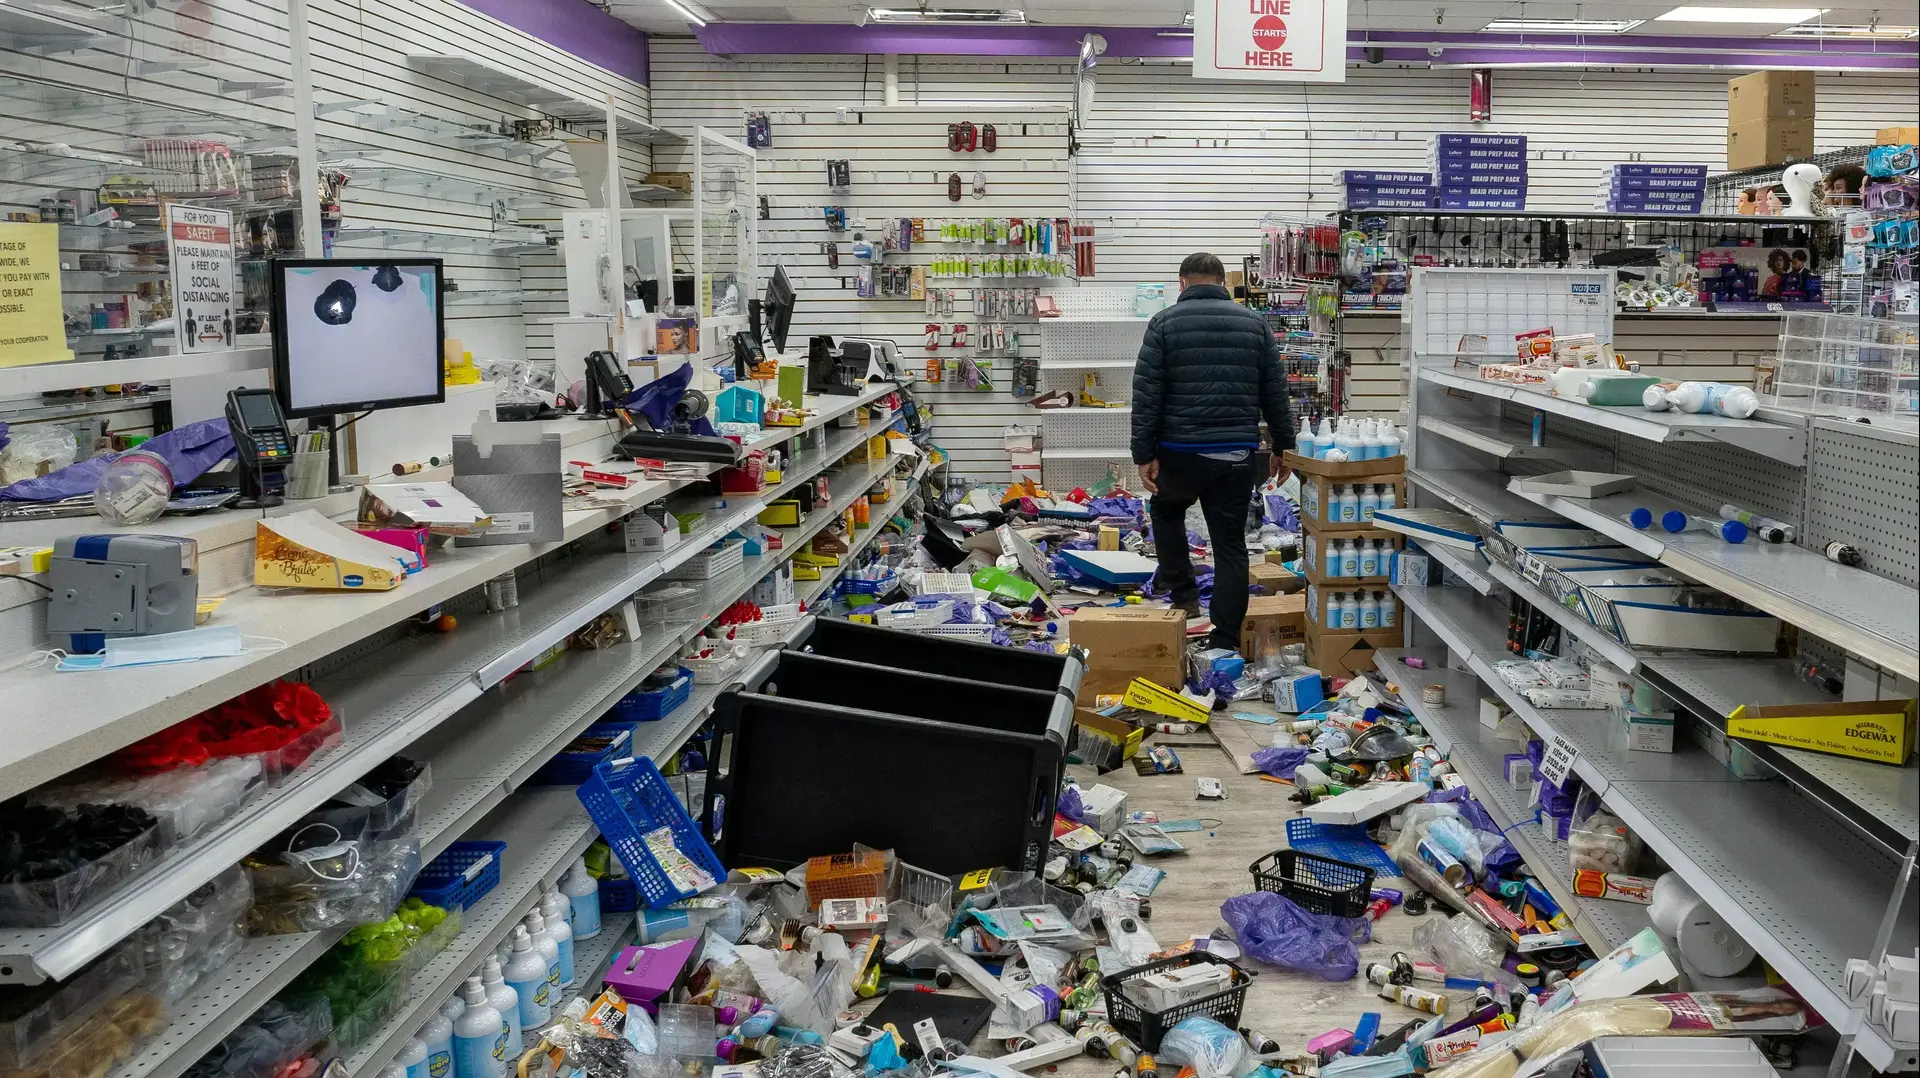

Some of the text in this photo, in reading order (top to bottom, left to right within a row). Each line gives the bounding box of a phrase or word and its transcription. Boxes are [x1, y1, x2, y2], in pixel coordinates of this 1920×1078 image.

[1250, 0, 1290, 15] LINE
[1252, 29, 1287, 37] STARTS
[1246, 51, 1293, 66] HERE
[184, 212, 216, 224] FOR YOUR
[186, 226, 216, 240] SAFETY
[176, 246, 230, 259] PLEASE MAINTAIN
[19, 258, 30, 266] WE
[191, 261, 195, 269] 6
[196, 262, 209, 270] FEET
[3, 273, 18, 281] YOU
[191, 276, 220, 288] SOCIAL
[2, 288, 33, 297] OR EXACT
[183, 291, 230, 303] DISTANCING
[1342, 294, 1373, 302] TOUCH DOWN
[1377, 294, 1393, 302] TOUCH
[204, 324, 216, 332] 6ft.
[16, 335, 48, 344] COOPERATION
[1738, 727, 1752, 735] More
[1773, 732, 1788, 741] More
[1789, 735, 1811, 744] Control
[1826, 741, 1846, 751] Flaking
[1845, 727, 1897, 744] EDGEWAX
[1554, 736, 1577, 757] FACE MASK
[1544, 766, 1558, 781] 50 PCS
[1180, 989, 1199, 999] Dove
